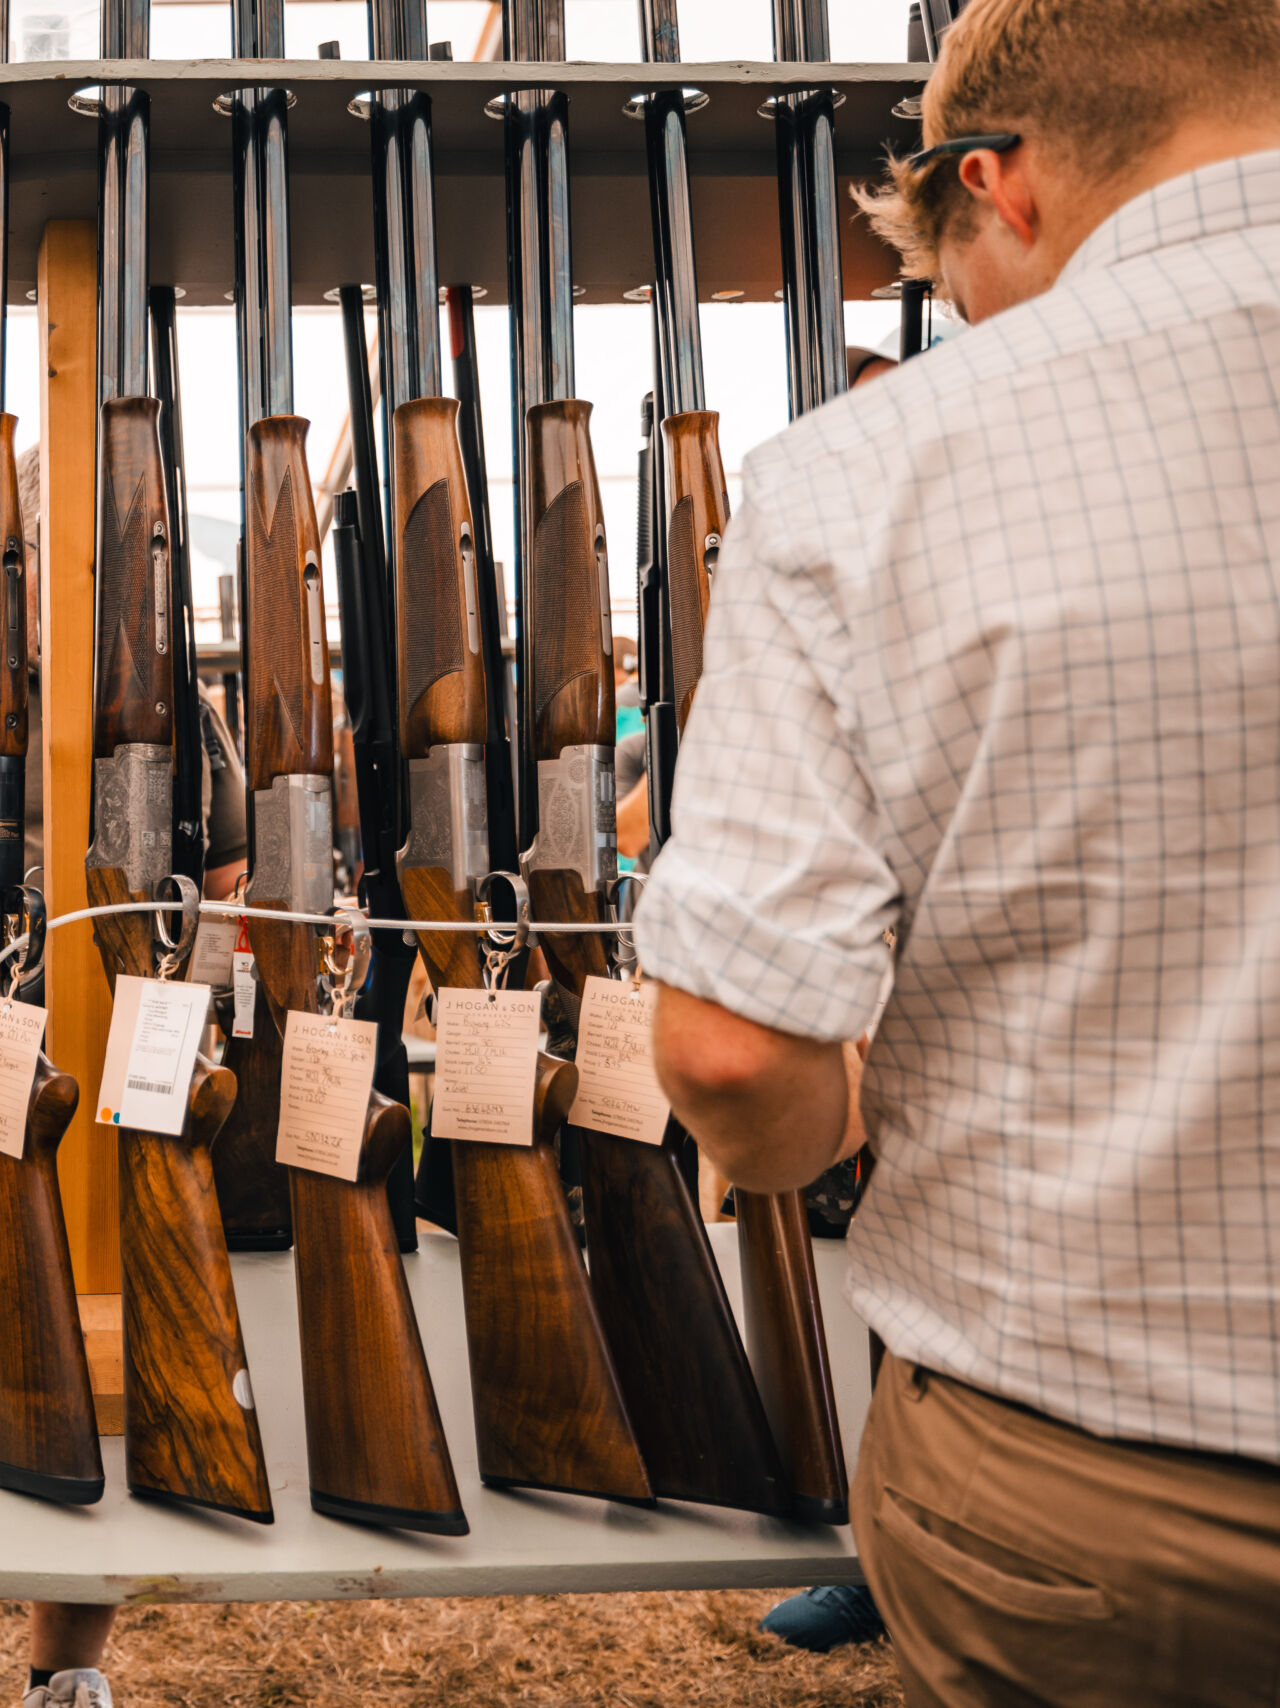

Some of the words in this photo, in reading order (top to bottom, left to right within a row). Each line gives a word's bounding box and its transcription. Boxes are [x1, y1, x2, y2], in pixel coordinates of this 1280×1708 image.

[445, 1000, 451, 1008] J
[456, 1001, 497, 1011] HOGAN
[510, 1003, 534, 1013] SON
[590, 991, 596, 1000] J
[601, 992, 645, 1009] HOGAN
[21, 1016, 40, 1030] SON
[292, 1024, 298, 1033] J
[302, 1026, 340, 1039] HOGAN
[351, 1033, 372, 1045] SON
